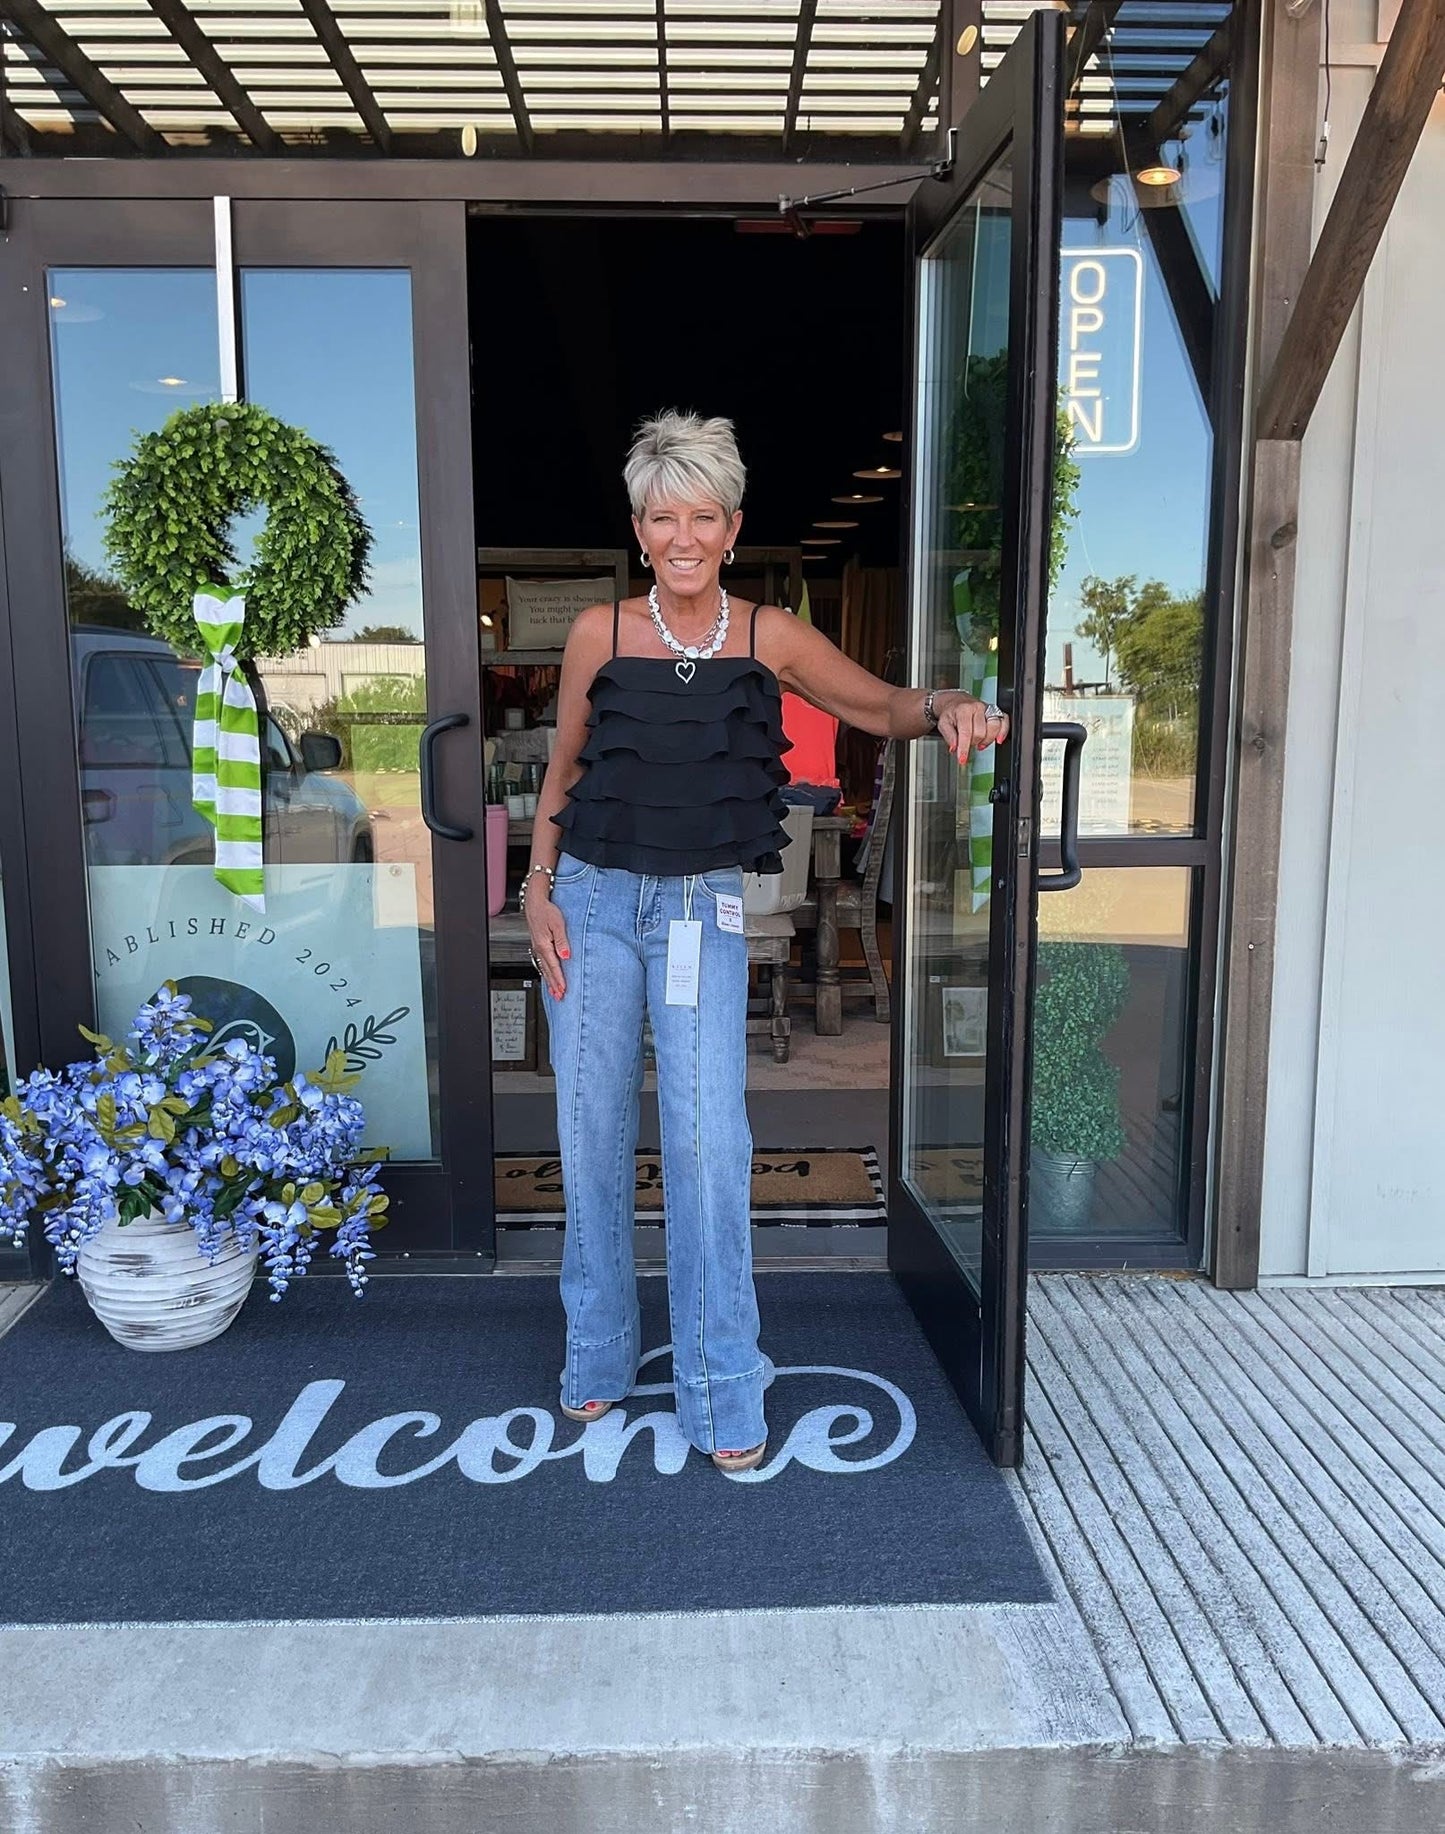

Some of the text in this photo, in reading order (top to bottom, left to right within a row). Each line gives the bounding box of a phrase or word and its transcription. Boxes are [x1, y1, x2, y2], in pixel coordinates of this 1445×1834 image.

[1067, 259, 1107, 443] OPEN
[518, 595, 538, 603] Your
[538, 595, 562, 604] crazy
[529, 605, 545, 614] You
[547, 605, 571, 615] might
[549, 615, 566, 624] that
[719, 907, 741, 918] CONTROL
[94, 917, 363, 1009] ABLISHED 2024
[0, 1345, 917, 1492] welcome
